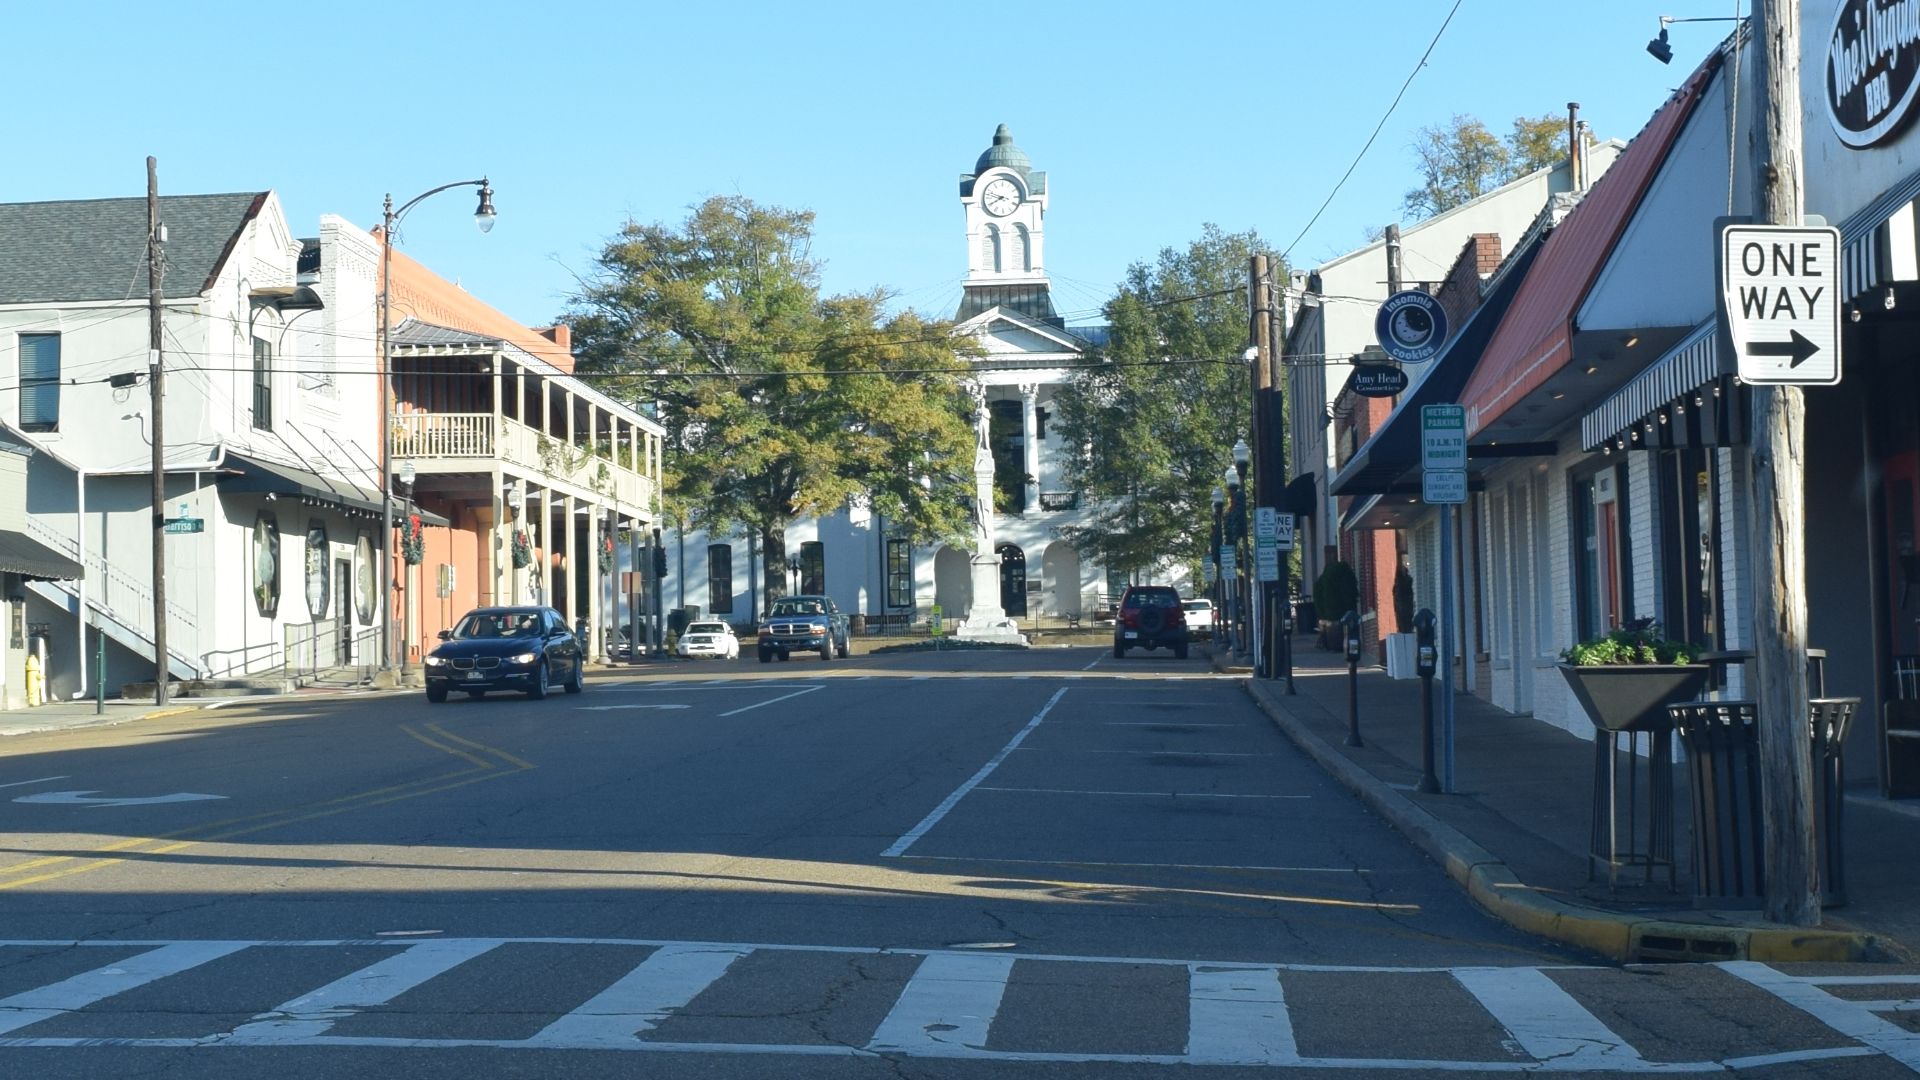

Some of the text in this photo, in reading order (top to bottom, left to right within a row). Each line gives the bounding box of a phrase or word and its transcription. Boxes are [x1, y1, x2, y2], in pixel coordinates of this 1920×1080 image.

[1742, 242, 1822, 276] ONE
[1739, 286, 1824, 320] WAY
[1392, 346, 1435, 360] cookies
[1354, 372, 1401, 387] Amy Head
[1426, 407, 1462, 417] METERED
[1427, 418, 1460, 427] PARKING
[1426, 438, 1436, 447] 10
[1452, 438, 1462, 447] TO
[1427, 449, 1461, 459] MIDNIGHT
[1275, 516, 1291, 526] NE
